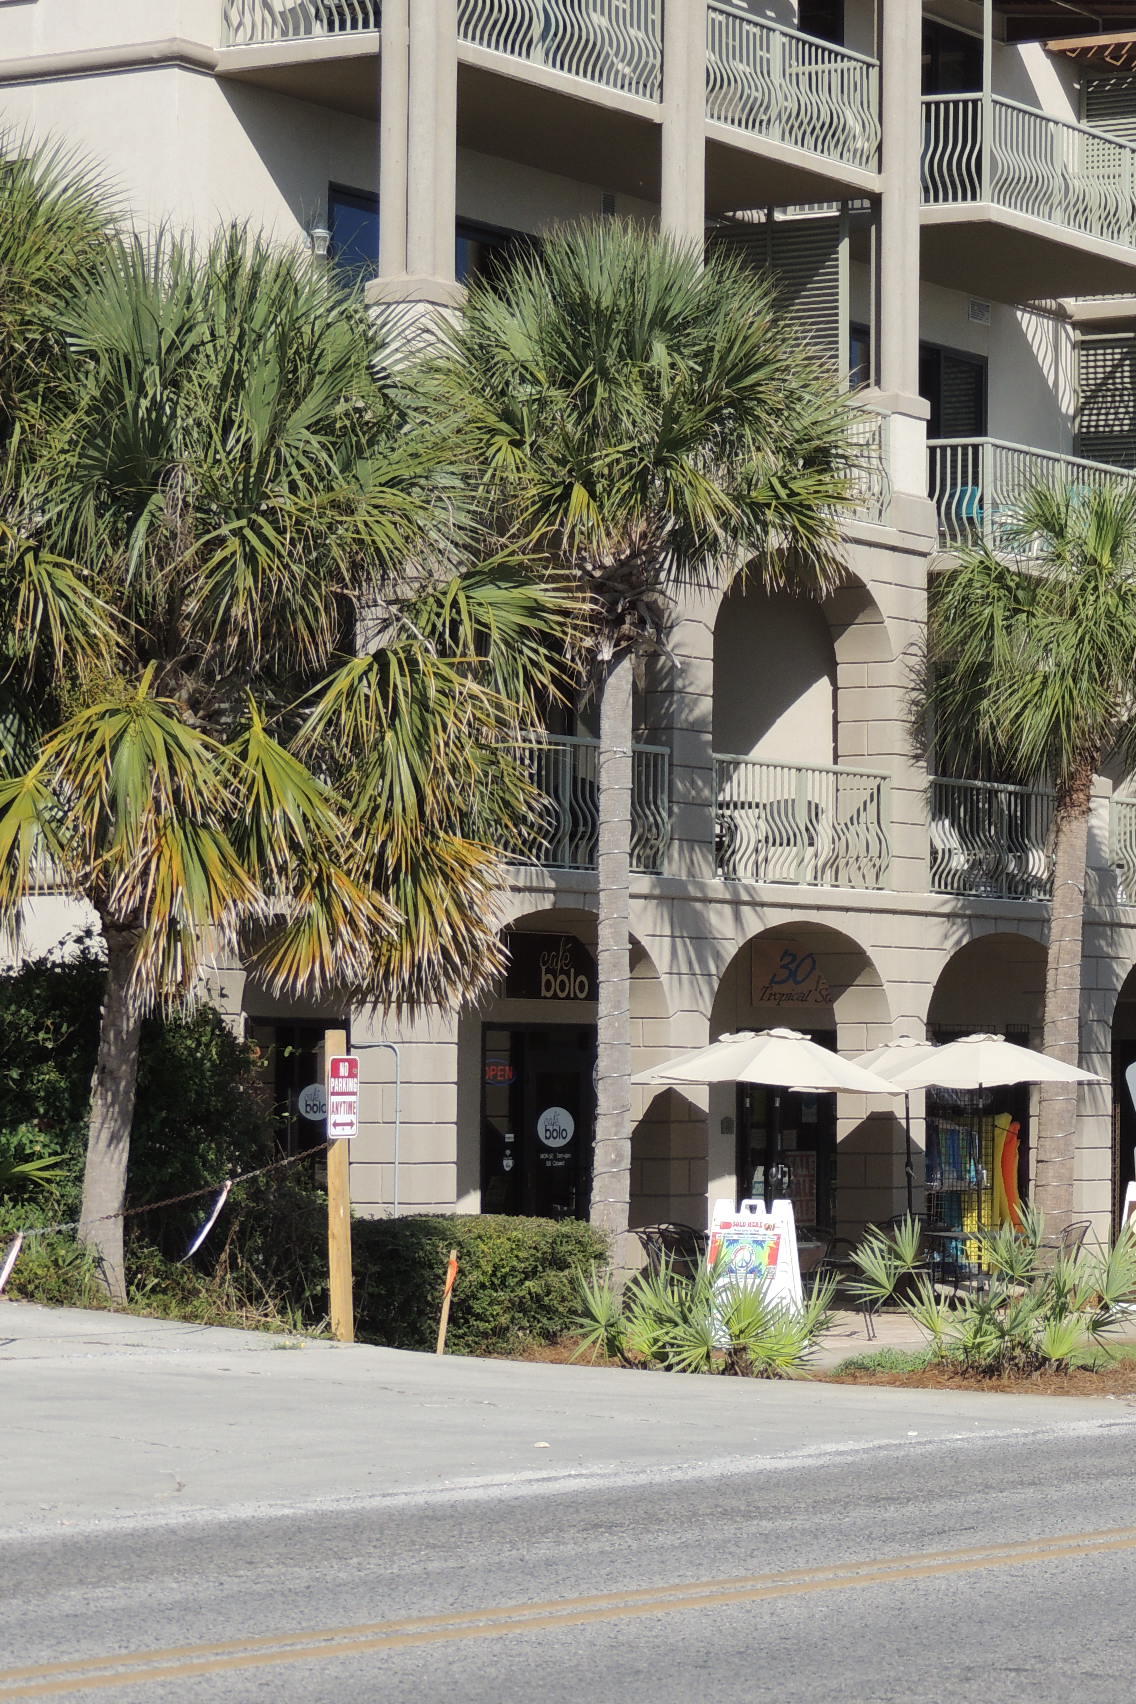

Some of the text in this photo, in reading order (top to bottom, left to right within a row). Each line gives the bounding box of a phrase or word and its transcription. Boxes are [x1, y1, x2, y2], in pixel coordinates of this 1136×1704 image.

[540, 936, 573, 976] café
[541, 968, 589, 999] bolo
[760, 984, 812, 1006] Tropical
[339, 1061, 349, 1077] NO
[331, 1078, 358, 1093] PARKING
[331, 1100, 356, 1115] ANYTIME
[545, 1125, 568, 1140] bolo
